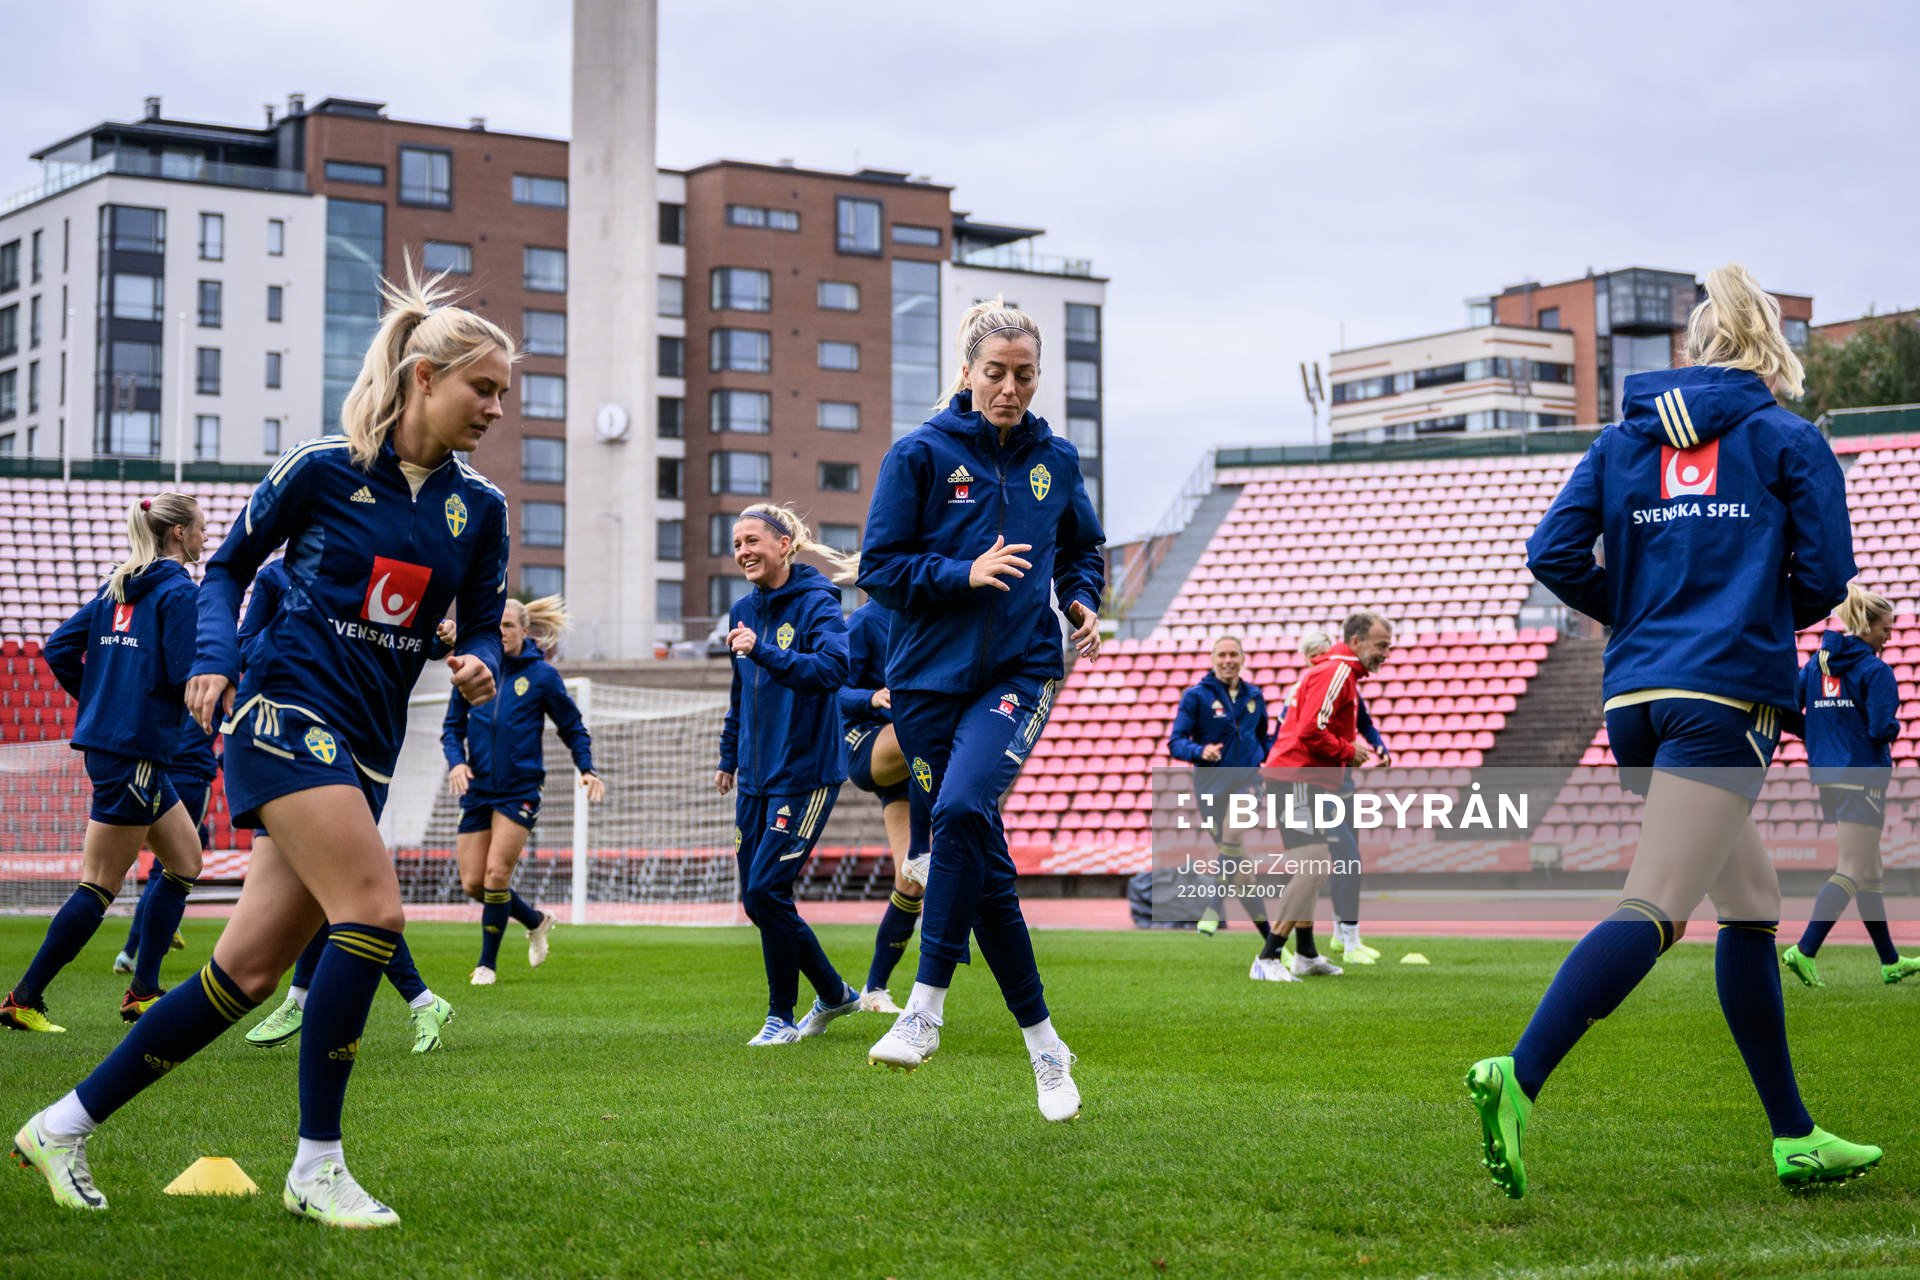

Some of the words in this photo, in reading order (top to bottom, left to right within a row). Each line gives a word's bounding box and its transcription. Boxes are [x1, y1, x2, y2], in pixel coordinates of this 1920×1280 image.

[947, 475, 974, 484] adidas
[1632, 503, 1702, 525] SVENSKA
[1706, 503, 1751, 518] SPEL
[328, 618, 395, 649] VENSKA
[397, 636, 423, 653] SPE
